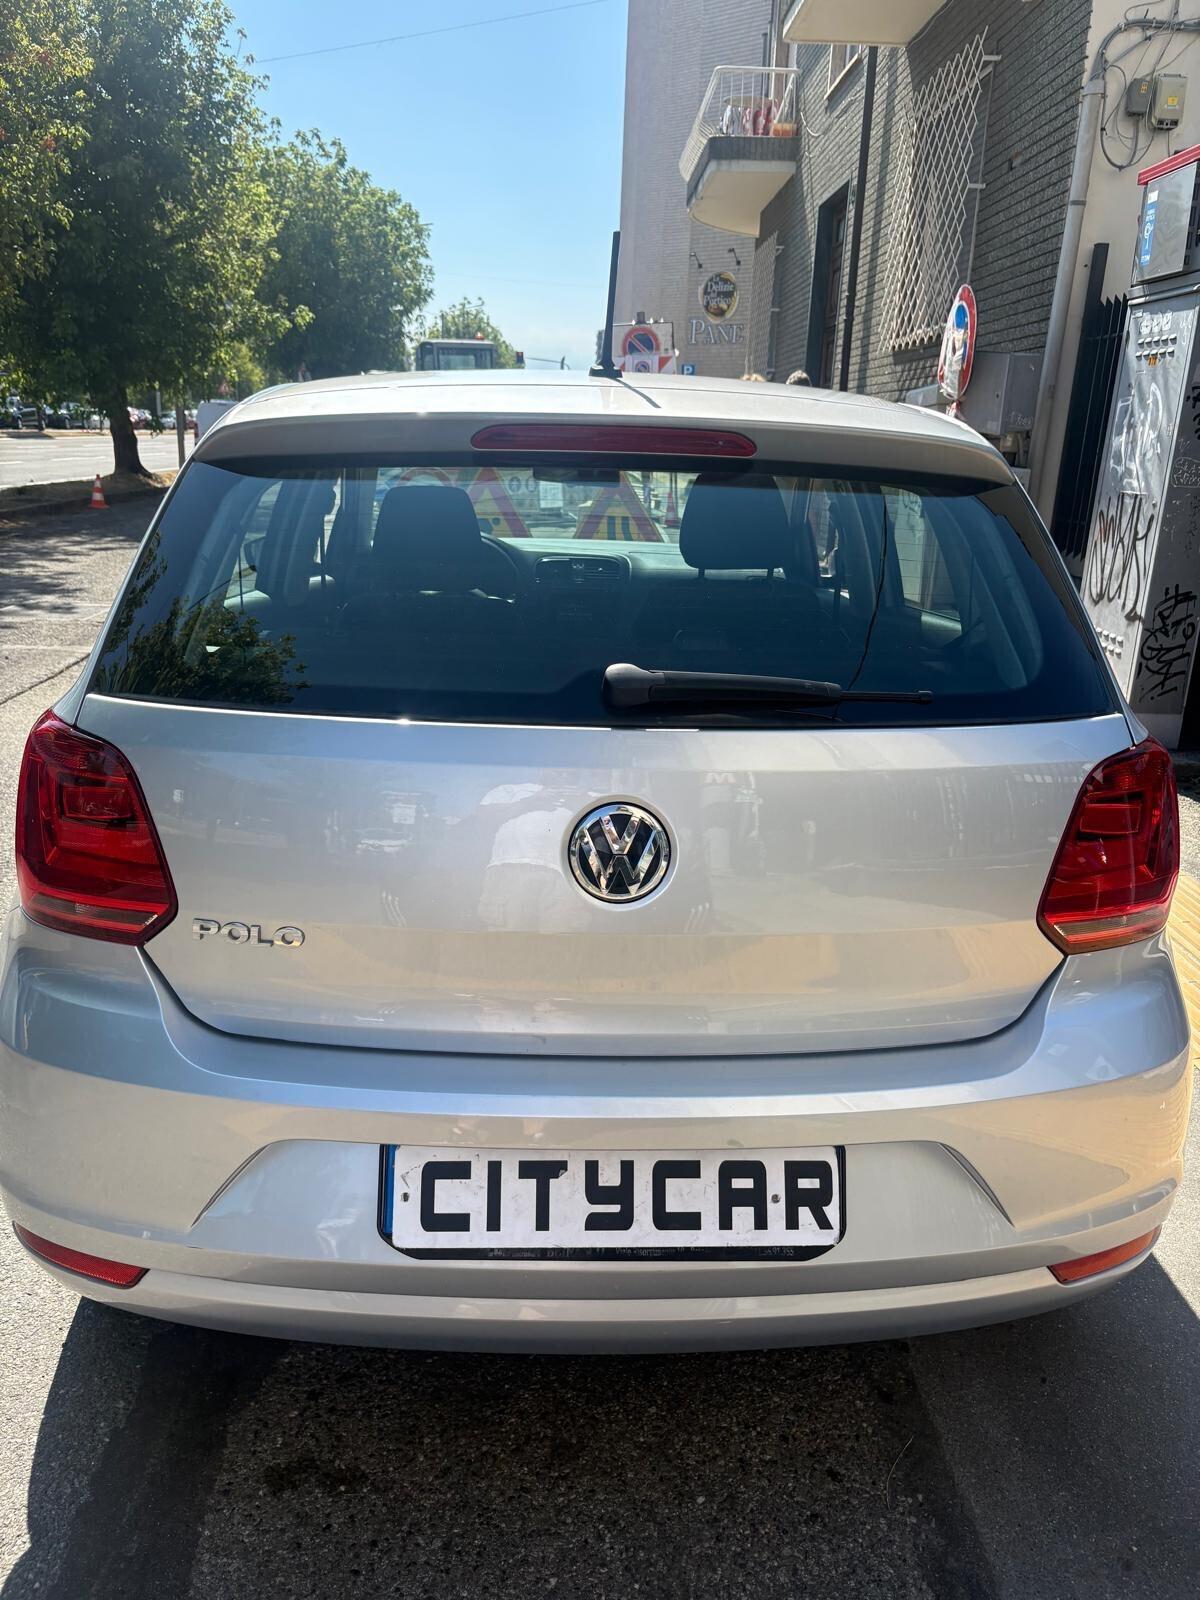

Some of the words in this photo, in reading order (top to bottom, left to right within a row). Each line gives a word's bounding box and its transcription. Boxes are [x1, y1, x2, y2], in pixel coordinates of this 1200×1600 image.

[707, 281, 734, 292] Delizie
[684, 365, 693, 375] P
[192, 917, 306, 948] POLO
[420, 1159, 834, 1232] CITYCAR
